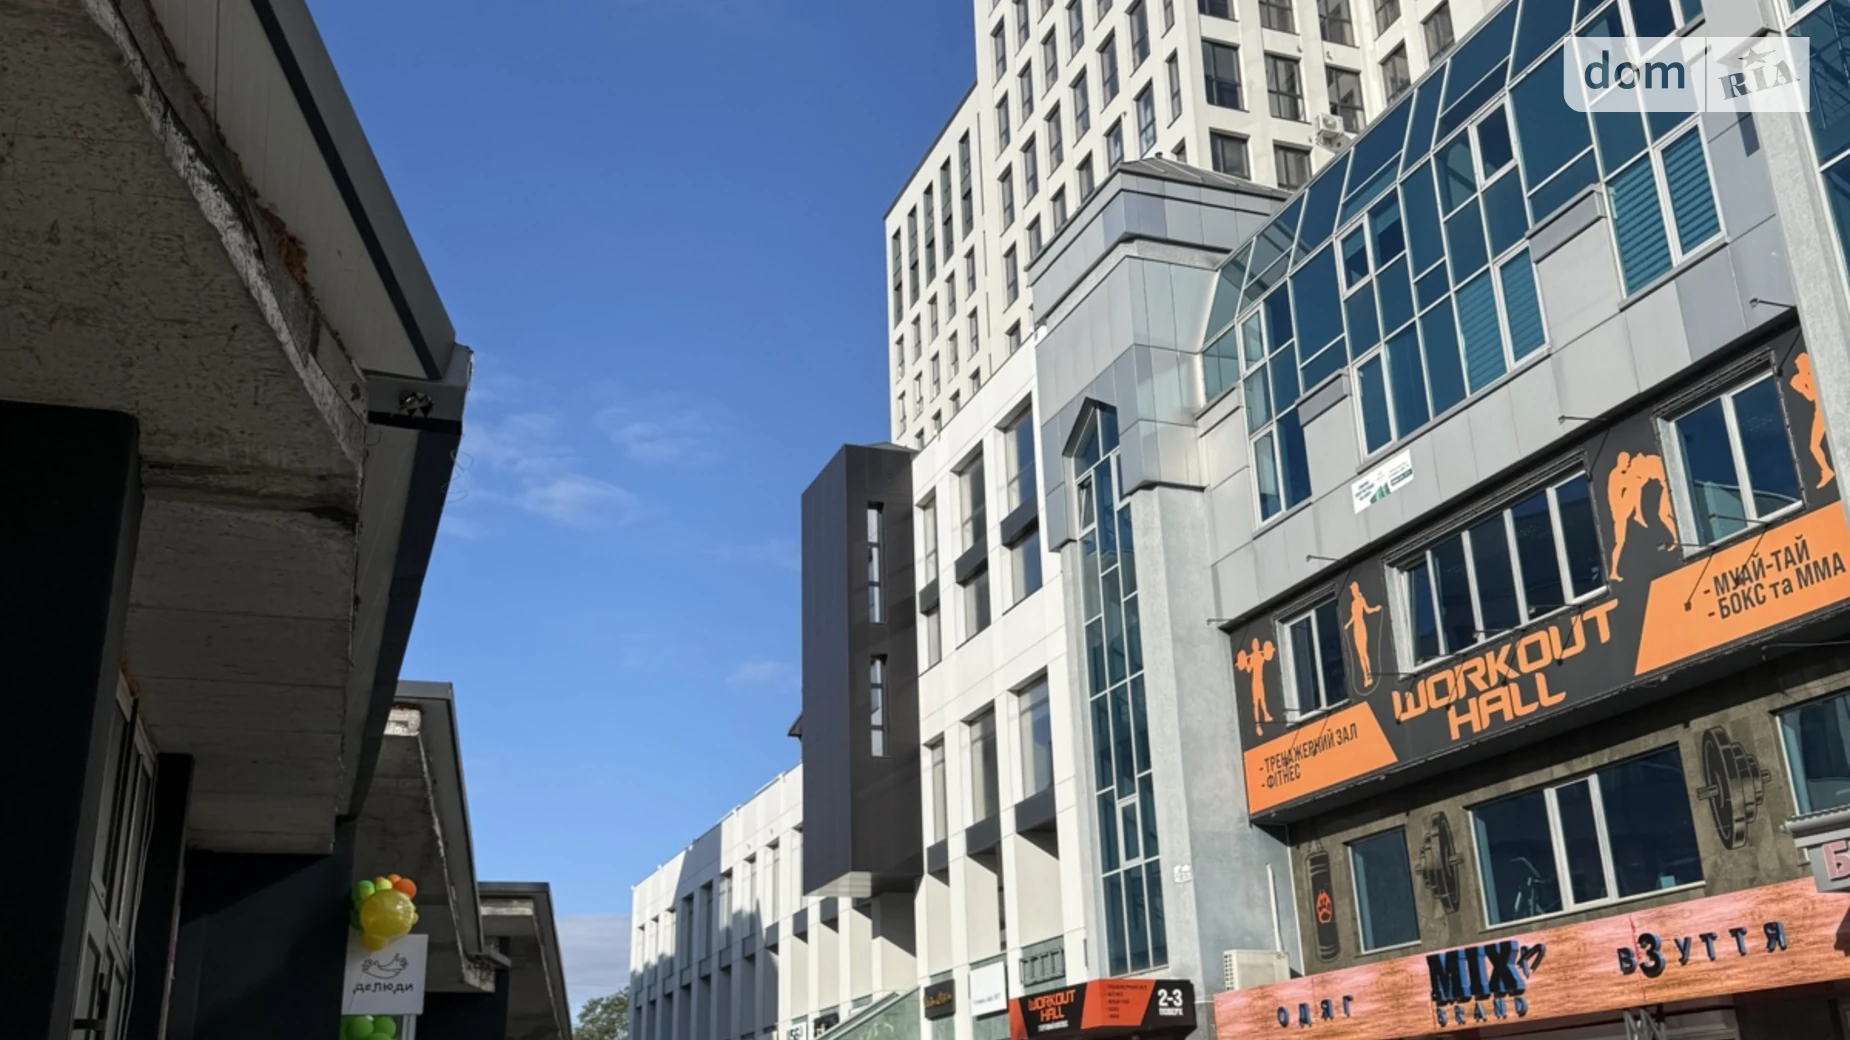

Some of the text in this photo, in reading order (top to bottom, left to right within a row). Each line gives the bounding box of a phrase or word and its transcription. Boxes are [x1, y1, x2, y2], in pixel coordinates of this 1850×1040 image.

[1717, 583, 1767, 619] БОКС
[1795, 551, 1847, 590] ММА
[1391, 598, 1619, 723] WORKOUT
[1447, 672, 1567, 741] HALL
[1335, 723, 1358, 746] ЗАЛ
[1266, 763, 1302, 789] ФІТНЕС
[1426, 940, 1525, 1005] MIX
[1028, 989, 1076, 1011] WORKOUT
[1157, 988, 1183, 1006] 2-3
[1277, 995, 1353, 1027] ОДЯГ
[1436, 997, 1528, 1027] BRAND
[1040, 1006, 1065, 1021] HALL
